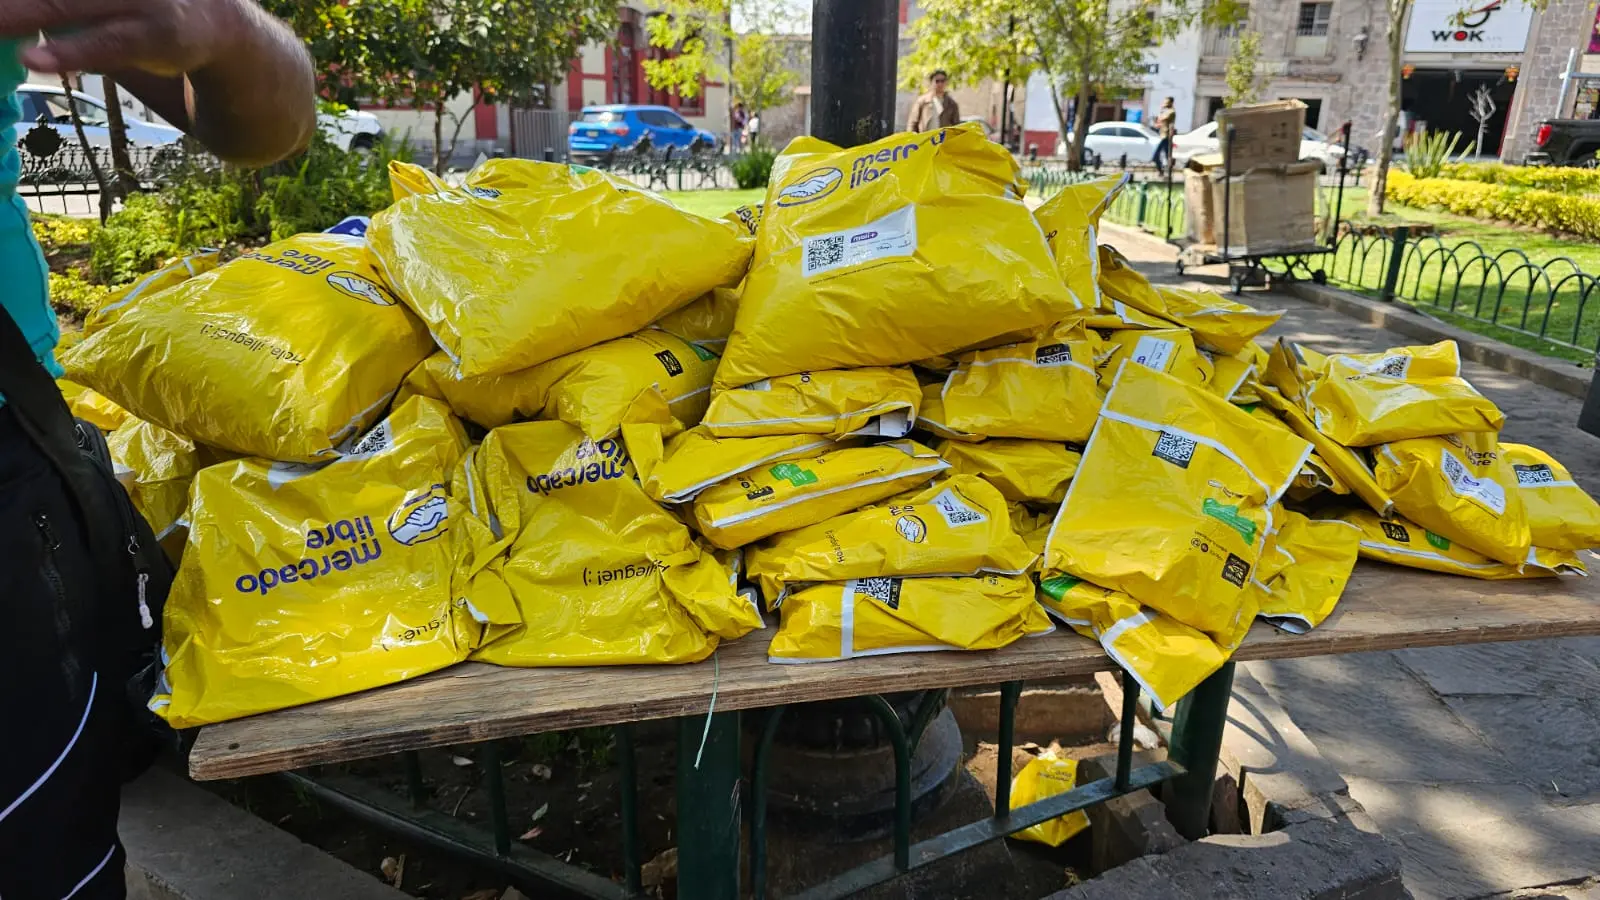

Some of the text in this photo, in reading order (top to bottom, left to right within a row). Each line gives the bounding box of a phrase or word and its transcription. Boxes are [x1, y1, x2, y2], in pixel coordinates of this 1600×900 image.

[1431, 30, 1485, 42] WOK
[282, 249, 336, 270] libre
[526, 459, 625, 496] mercado
[306, 515, 375, 549] libre
[236, 538, 383, 596] mercado
